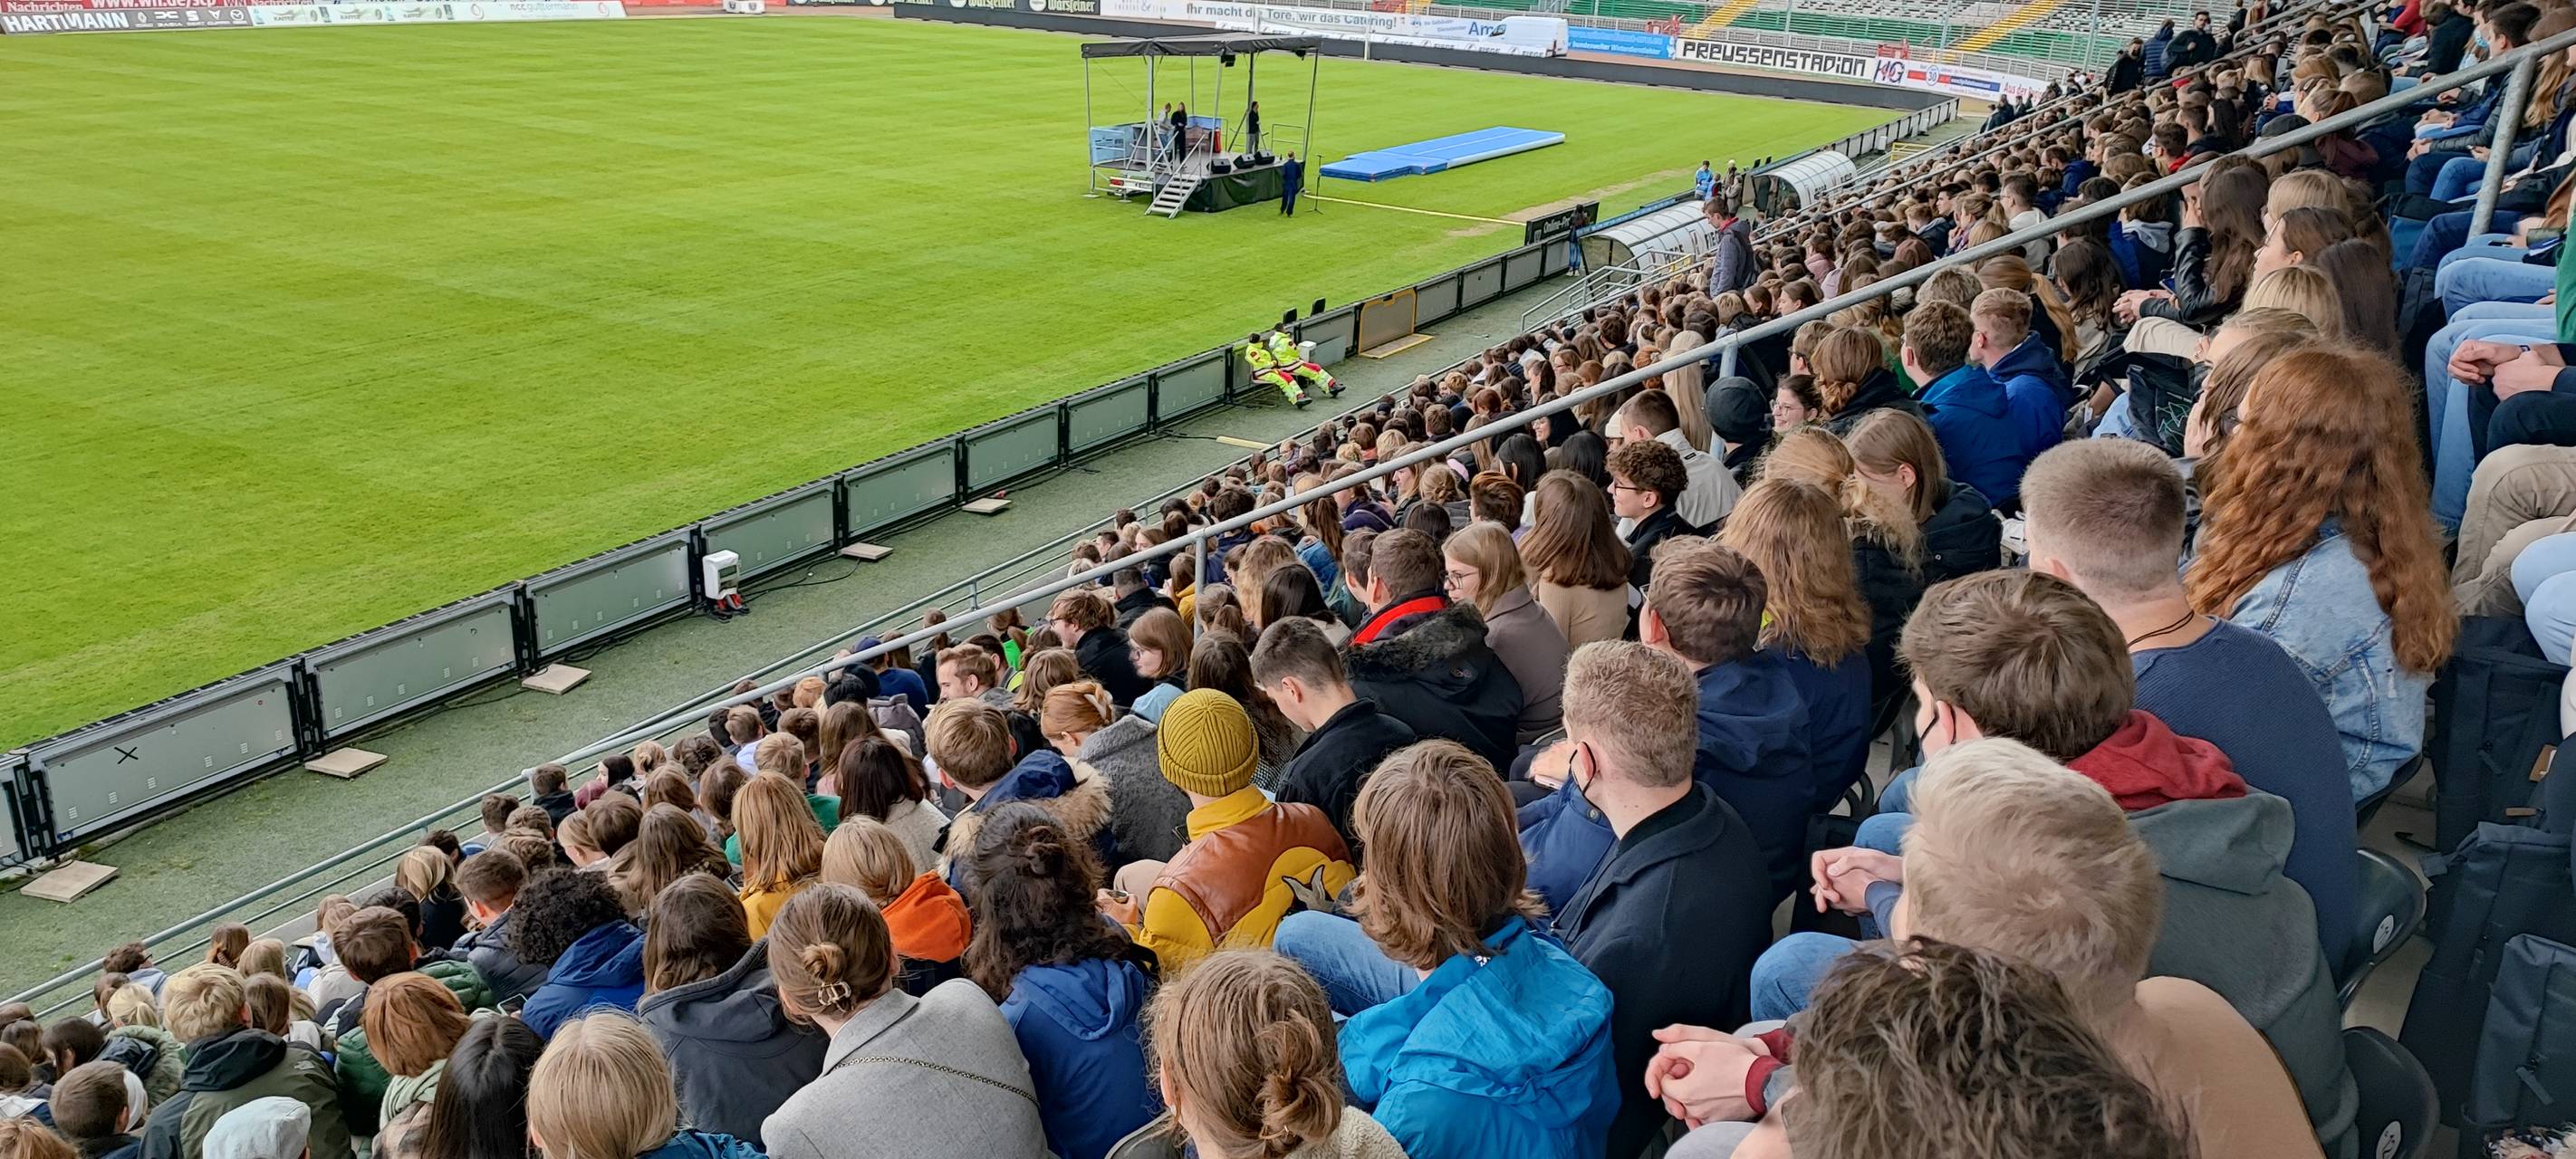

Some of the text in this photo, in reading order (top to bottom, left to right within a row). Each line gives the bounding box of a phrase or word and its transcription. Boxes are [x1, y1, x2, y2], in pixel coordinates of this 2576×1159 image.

[1187, 3, 1203, 14] Ihr
[1206, 5, 1242, 18] macht
[1298, 11, 1316, 23] wir
[1320, 13, 1341, 24] das
[1467, 21, 1494, 36] Am
